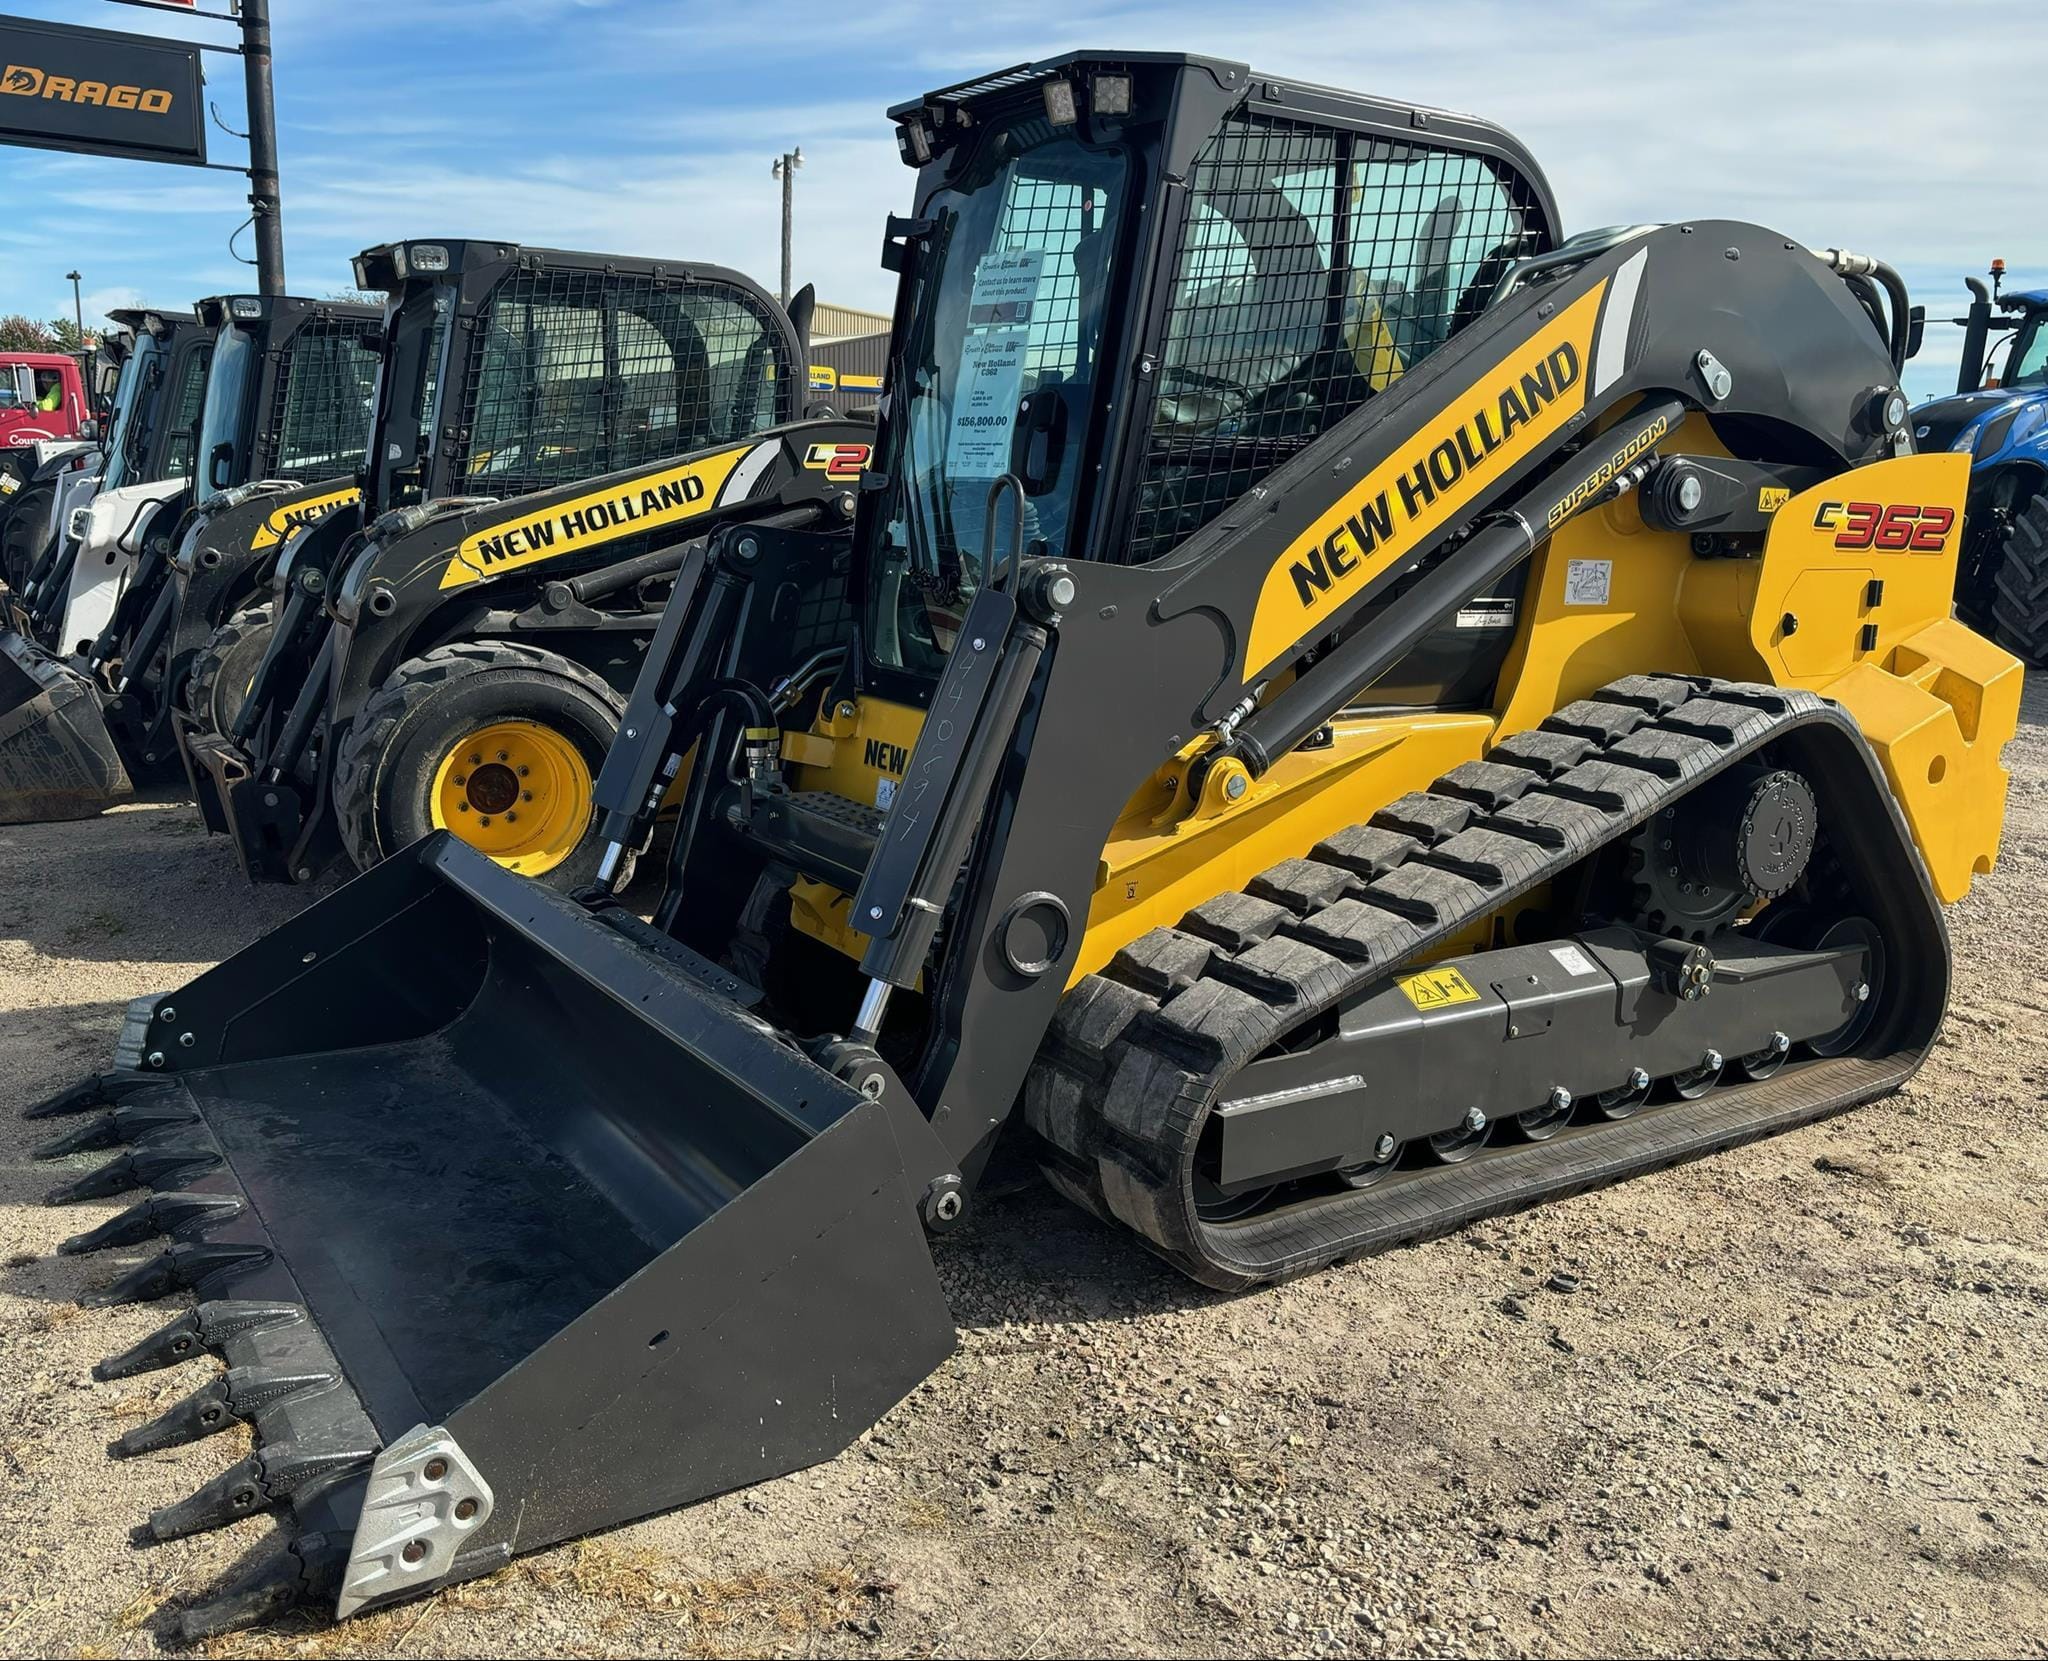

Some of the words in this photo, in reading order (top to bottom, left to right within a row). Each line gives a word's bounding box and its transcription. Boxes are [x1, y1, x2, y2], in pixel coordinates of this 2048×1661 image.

[0, 64, 173, 114] DRAGO
[996, 287, 1004, 295] this
[1009, 276, 1021, 284] learn
[973, 360, 987, 368] New
[987, 358, 1016, 368] Holland
[957, 416, 1008, 428] $156,800.00
[804, 444, 874, 481] L2
[1287, 490, 1396, 610] NEW
[1395, 340, 1581, 521] HOLLAND
[1547, 462, 1613, 529] SUPER
[1611, 415, 1668, 474] BOOM
[477, 519, 555, 566] NEW
[560, 474, 705, 540] HOLLAND
[1813, 501, 1956, 553] C362
[863, 738, 909, 776] NEW
